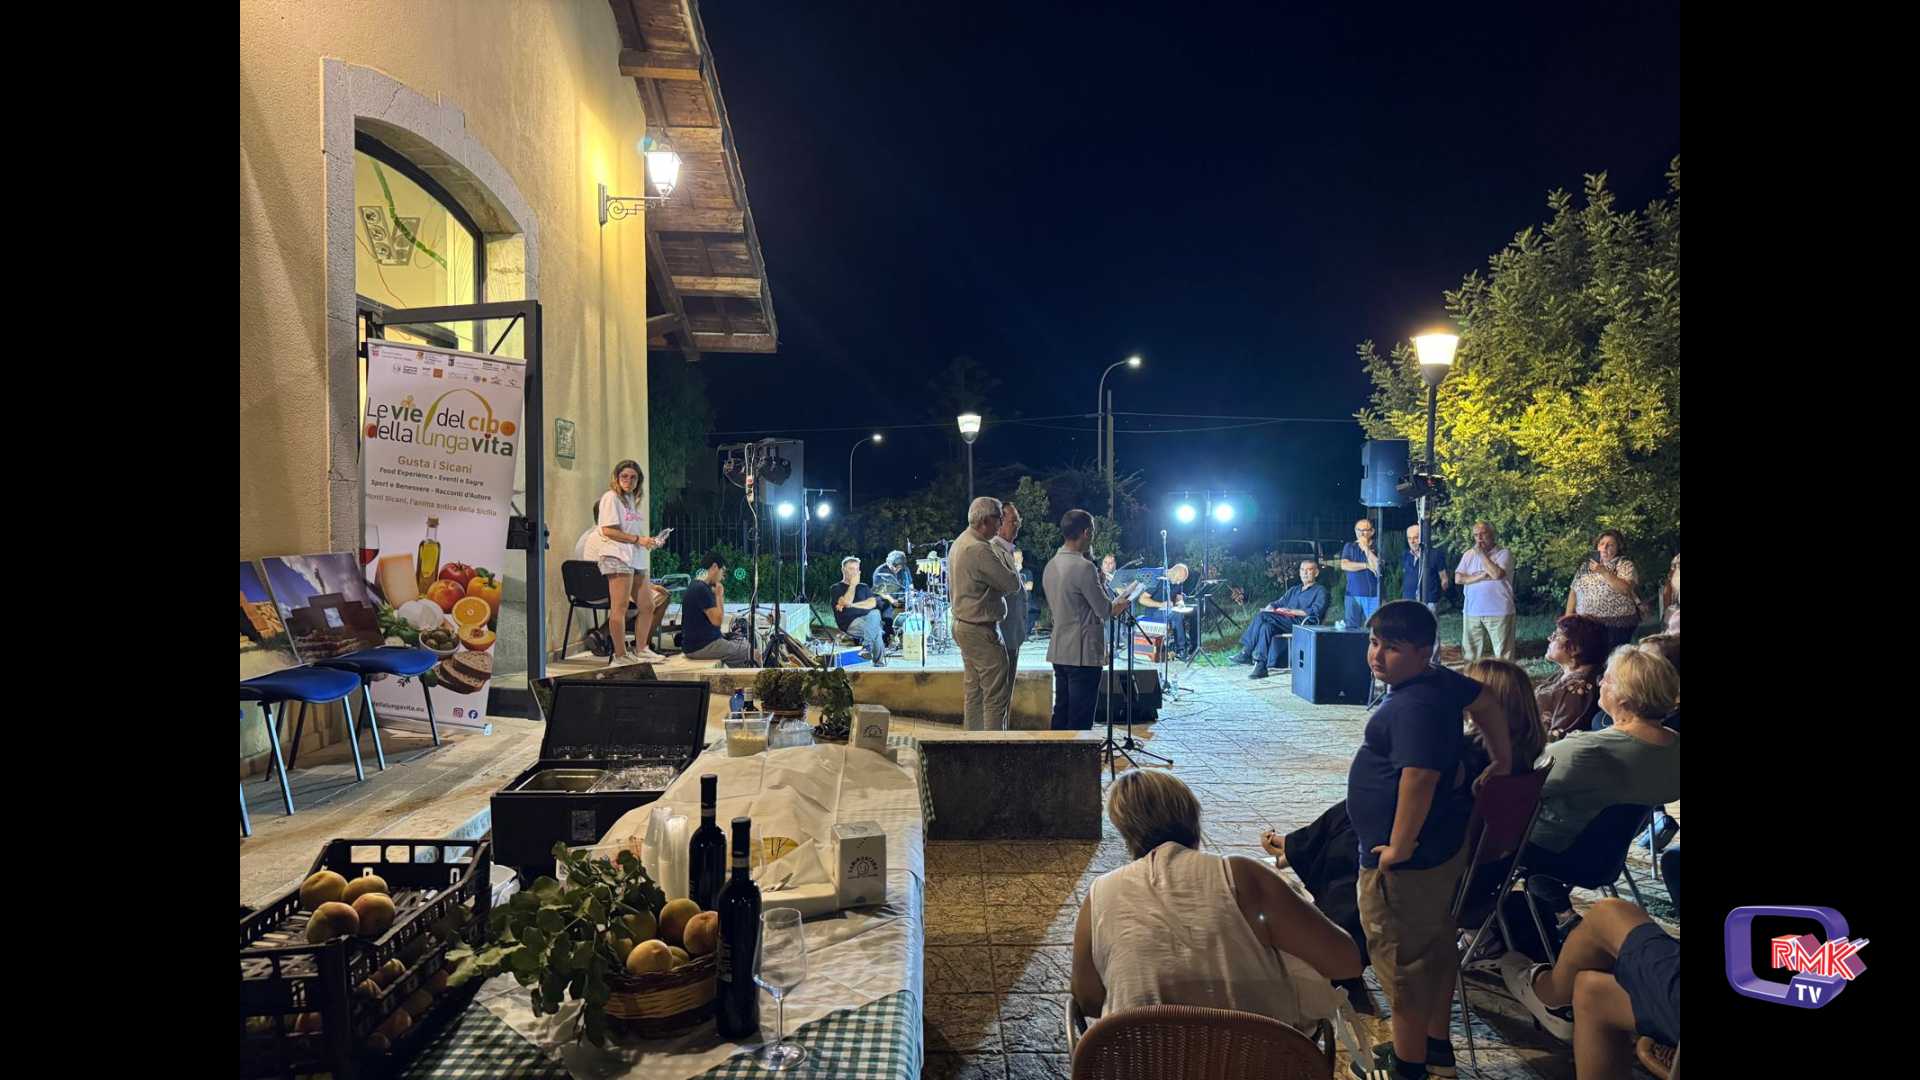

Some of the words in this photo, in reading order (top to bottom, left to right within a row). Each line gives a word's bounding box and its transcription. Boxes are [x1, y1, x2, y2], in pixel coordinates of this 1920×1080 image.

[367, 396, 388, 418] Le
[391, 402, 423, 423] vie
[436, 408, 465, 429] del
[415, 424, 469, 455] lunga
[471, 433, 513, 456] vita
[398, 455, 430, 469] Gusta
[439, 460, 472, 474] Sicani
[371, 479, 388, 488] Sport
[395, 482, 429, 493] Benessere
[435, 487, 463, 497] Racconti
[379, 466, 396, 475] Food
[397, 468, 433, 480] Experience
[439, 474, 459, 485] Eventi
[465, 478, 484, 488] Sagre
